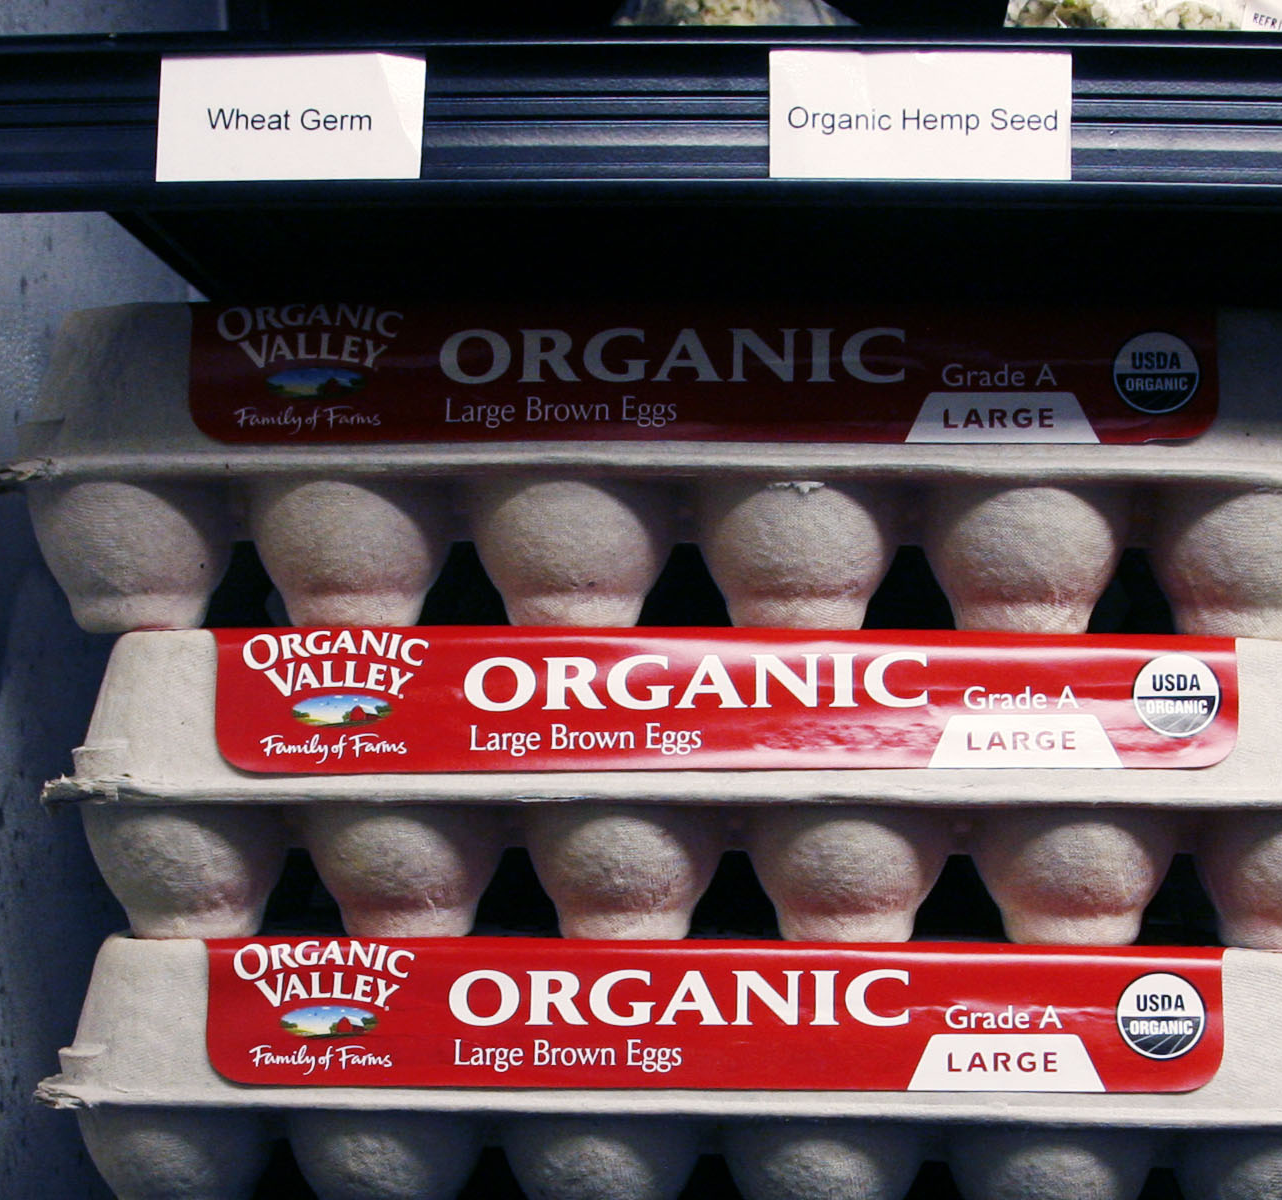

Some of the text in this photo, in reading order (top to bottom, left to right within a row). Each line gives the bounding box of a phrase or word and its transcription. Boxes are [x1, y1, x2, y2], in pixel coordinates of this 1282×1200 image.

[206, 106, 374, 132] Wheat Germ
[787, 106, 1060, 136] Organic Hemp Seed
[438, 327, 906, 385] ORGANIC
[943, 407, 1055, 429] LARGE
[242, 629, 430, 673] ORGANIC
[262, 659, 416, 700] VALLEY
[462, 651, 931, 713] ORGANIC
[1151, 672, 1202, 694] USDA
[963, 685, 1080, 711] Grade A
[1144, 698, 1210, 716] ORGANIC
[258, 733, 331, 765] Family
[352, 733, 409, 757] Farms
[468, 721, 704, 758] Large Brown Eggs
[966, 730, 1078, 752] LARGE
[233, 939, 416, 983] ORGANIC
[253, 969, 403, 1011] VALLEY
[447, 969, 911, 1028] ORGANIC
[1135, 992, 1187, 1013] USDA
[943, 1004, 1063, 1031] Grade A
[1128, 1018, 1195, 1037] ORGANIC
[248, 1043, 318, 1076] Family
[338, 1043, 394, 1069] Farms
[453, 1038, 683, 1074] Large Brown Eggs
[946, 1051, 1059, 1074] LARGE
